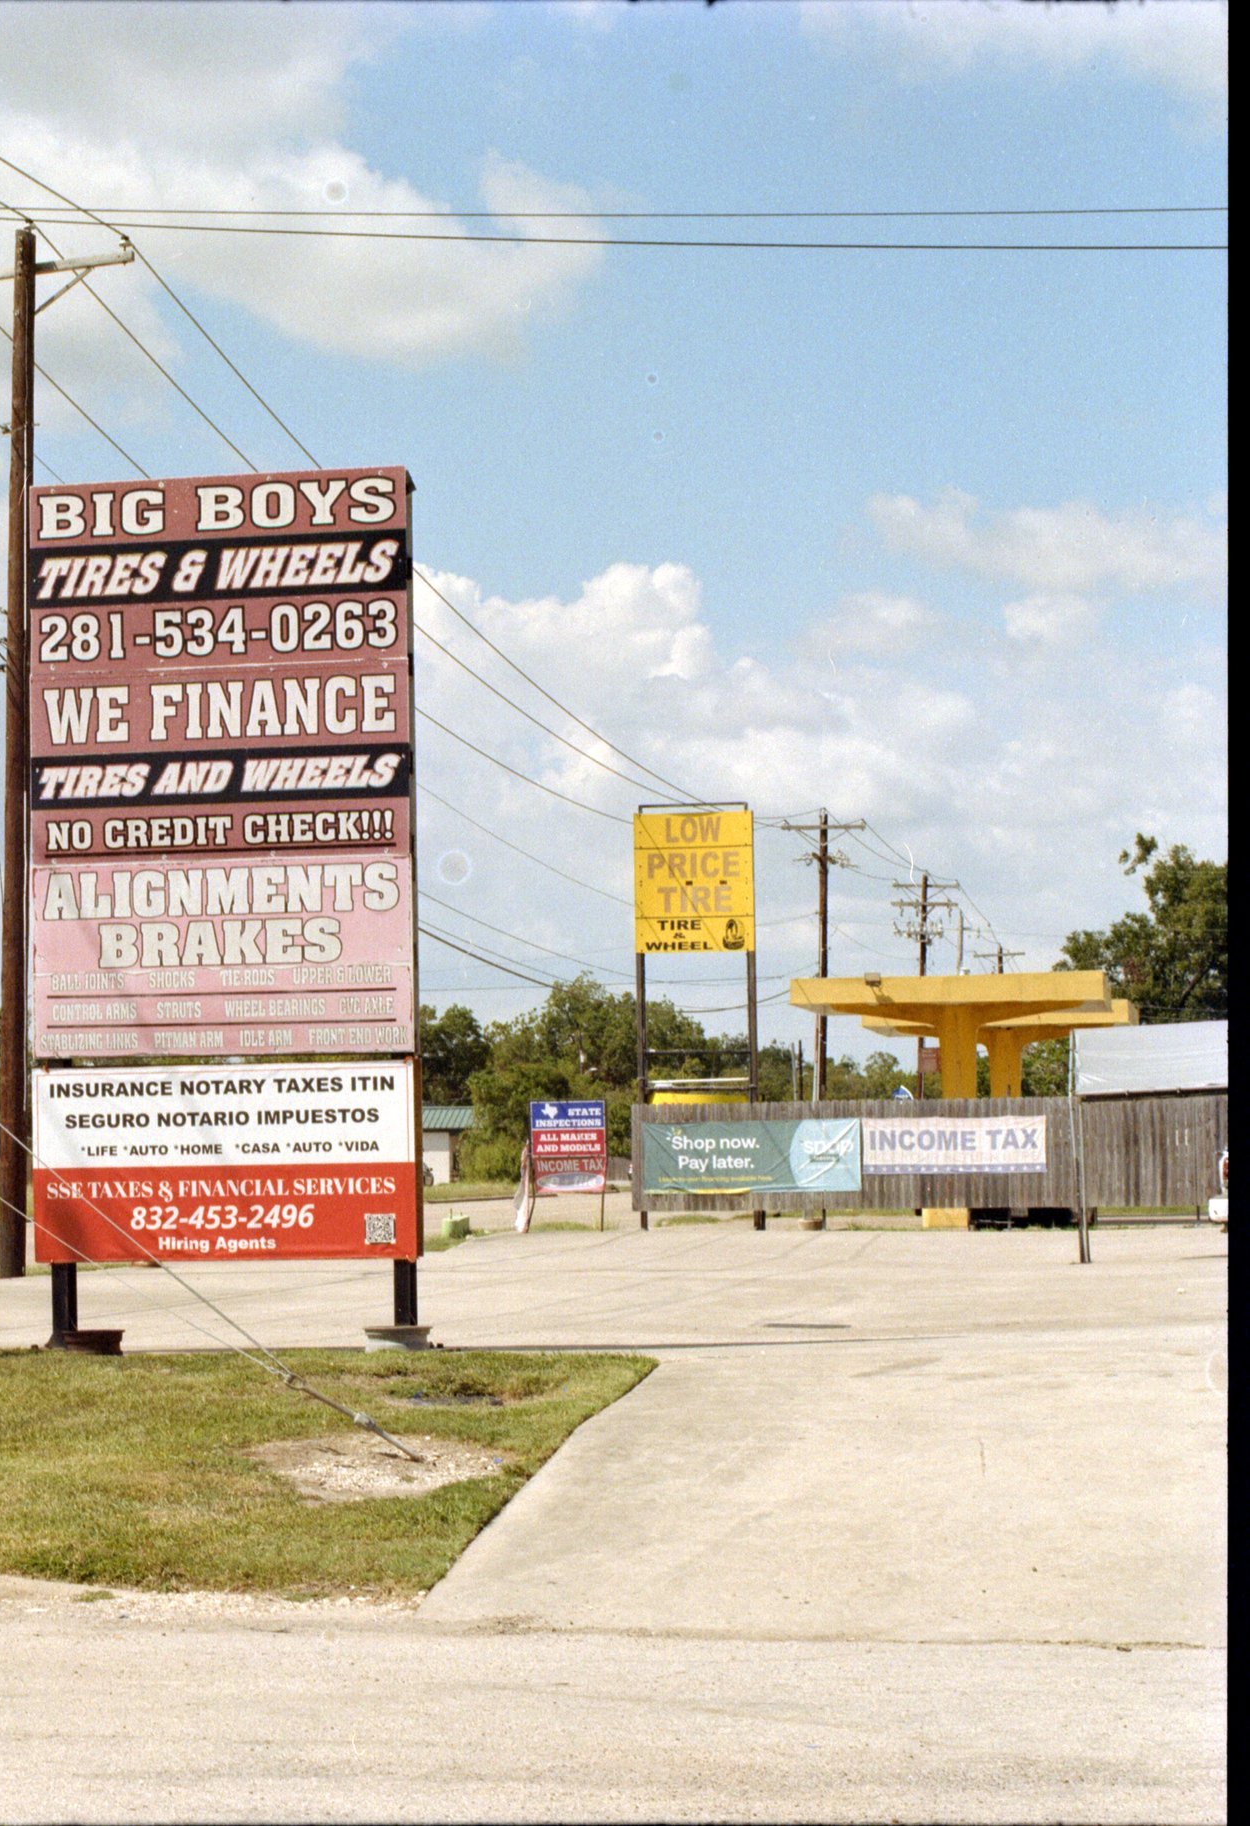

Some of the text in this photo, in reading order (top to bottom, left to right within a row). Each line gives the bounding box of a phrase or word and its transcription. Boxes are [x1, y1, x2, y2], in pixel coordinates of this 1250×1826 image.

[37, 476, 396, 540] BIG BOYS
[36, 540, 400, 600] TIRES & WHEELS
[38, 600, 399, 662] 281-534-0263
[42, 672, 396, 746] WE FINANCE
[38, 753, 402, 800] TIRES AND WHEELS
[46, 809, 394, 852] NO CREDIT CHECK!!!
[665, 816, 721, 844] LOW
[647, 851, 740, 880] PRICE
[43, 861, 400, 922] ALIGNMENTS
[657, 885, 733, 913] TIRE
[657, 919, 701, 931] TIRE
[98, 916, 344, 969] BRAKES
[646, 942, 713, 951] WHEEL
[52, 965, 391, 991] BALL JOINTS SHOCKS TIE-RODS UPPER & LOWER
[52, 1003, 102, 1021] CONTROL
[106, 1002, 137, 1020] ARMS
[156, 1001, 201, 1019] STRUTS
[225, 1000, 265, 1017] WHEEL
[269, 998, 325, 1016] BEARINGS
[365, 997, 393, 1014] AXLE
[40, 1026, 408, 1050] STABLIZING LINKS PITMAN ARM IDLE ARM FRONT END WORK
[50, 1076, 395, 1098] INSURANCE NOTARY TAXES ITIN
[65, 1108, 379, 1129] SEGURO NOTARIO IMPUESTOS
[535, 1119, 601, 1128] INSPECTIONS
[568, 1107, 601, 1116] STATE
[536, 1143, 601, 1152] AND MODELS
[560, 1133, 597, 1141] MAKES
[671, 1135, 760, 1152] Shop now.
[869, 1128, 1038, 1151] INCOME TAX
[537, 1158, 603, 1172] INCOME TAX
[678, 1155, 754, 1173] Pay later.
[46, 1177, 396, 1202] SSE TAXES & FINANCIAL SERVICES
[130, 1204, 315, 1230] 832-453-2496
[158, 1236, 276, 1253] Hiring Agents
